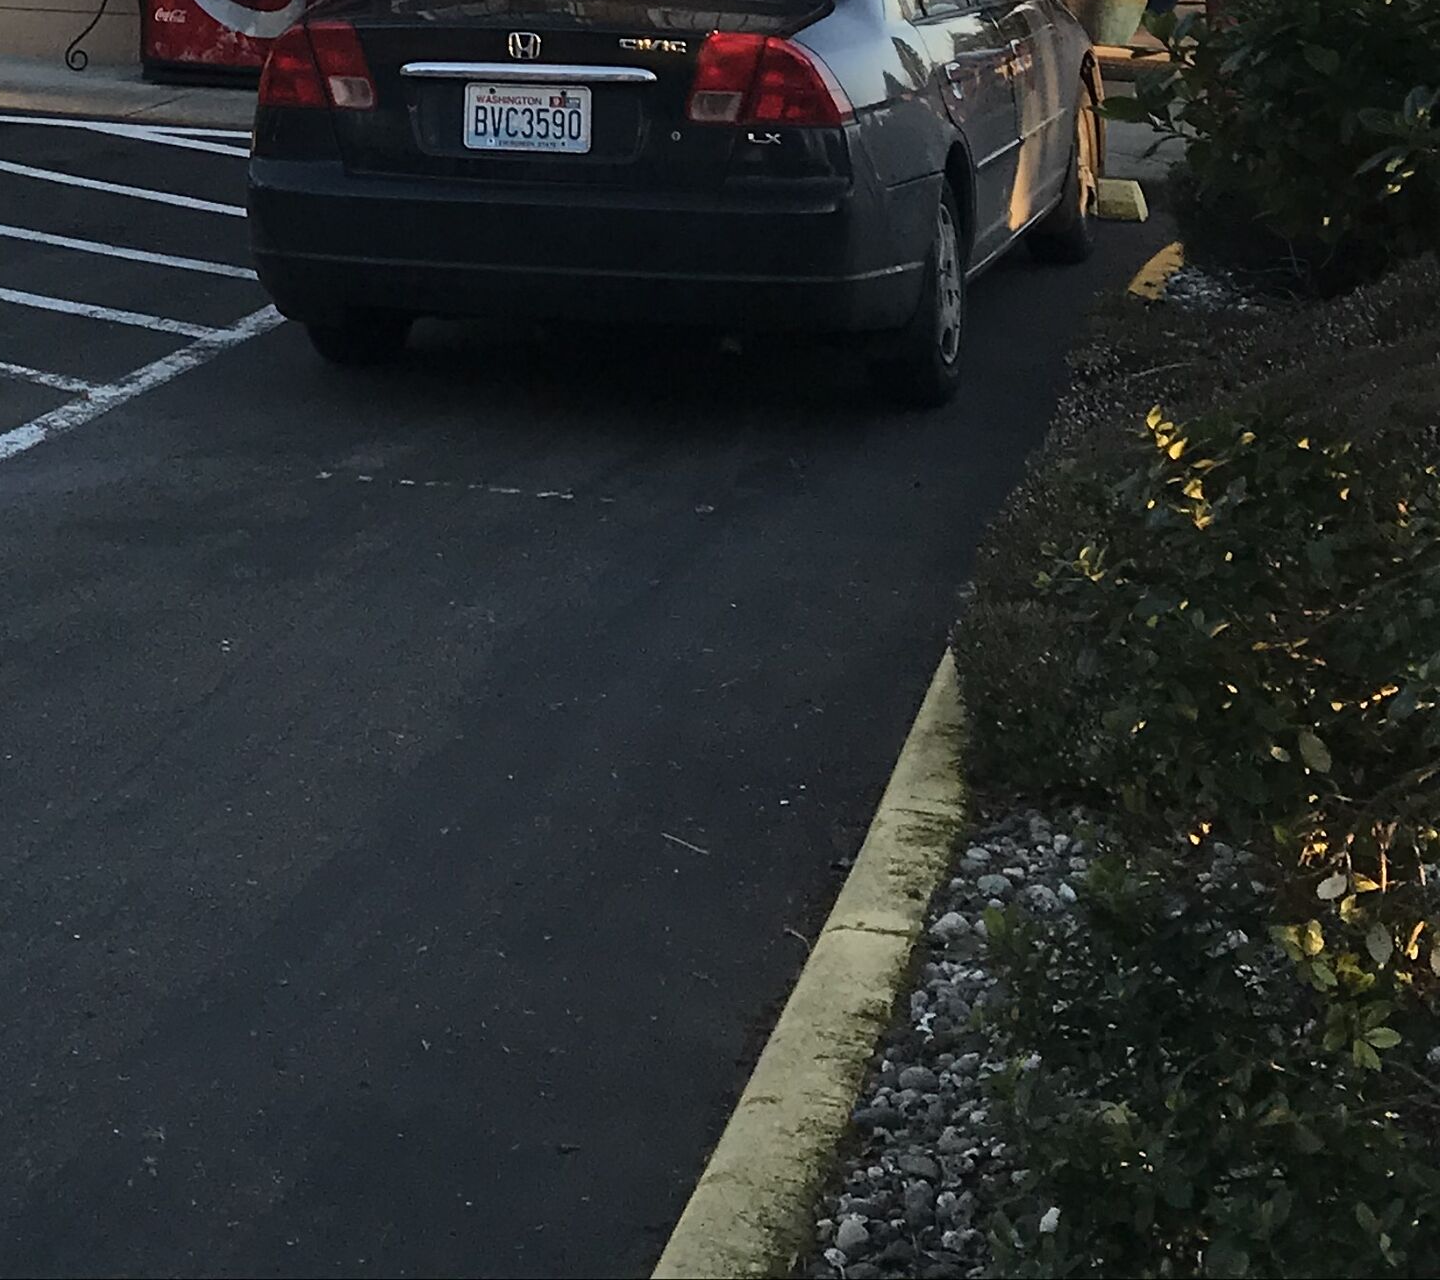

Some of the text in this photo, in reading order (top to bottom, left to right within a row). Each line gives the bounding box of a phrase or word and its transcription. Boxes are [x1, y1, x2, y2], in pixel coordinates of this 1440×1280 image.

[619, 38, 687, 54] CIVIC
[475, 95, 543, 106] WASHINGTON
[474, 105, 582, 141] BVC3590
[747, 132, 782, 145] LX
